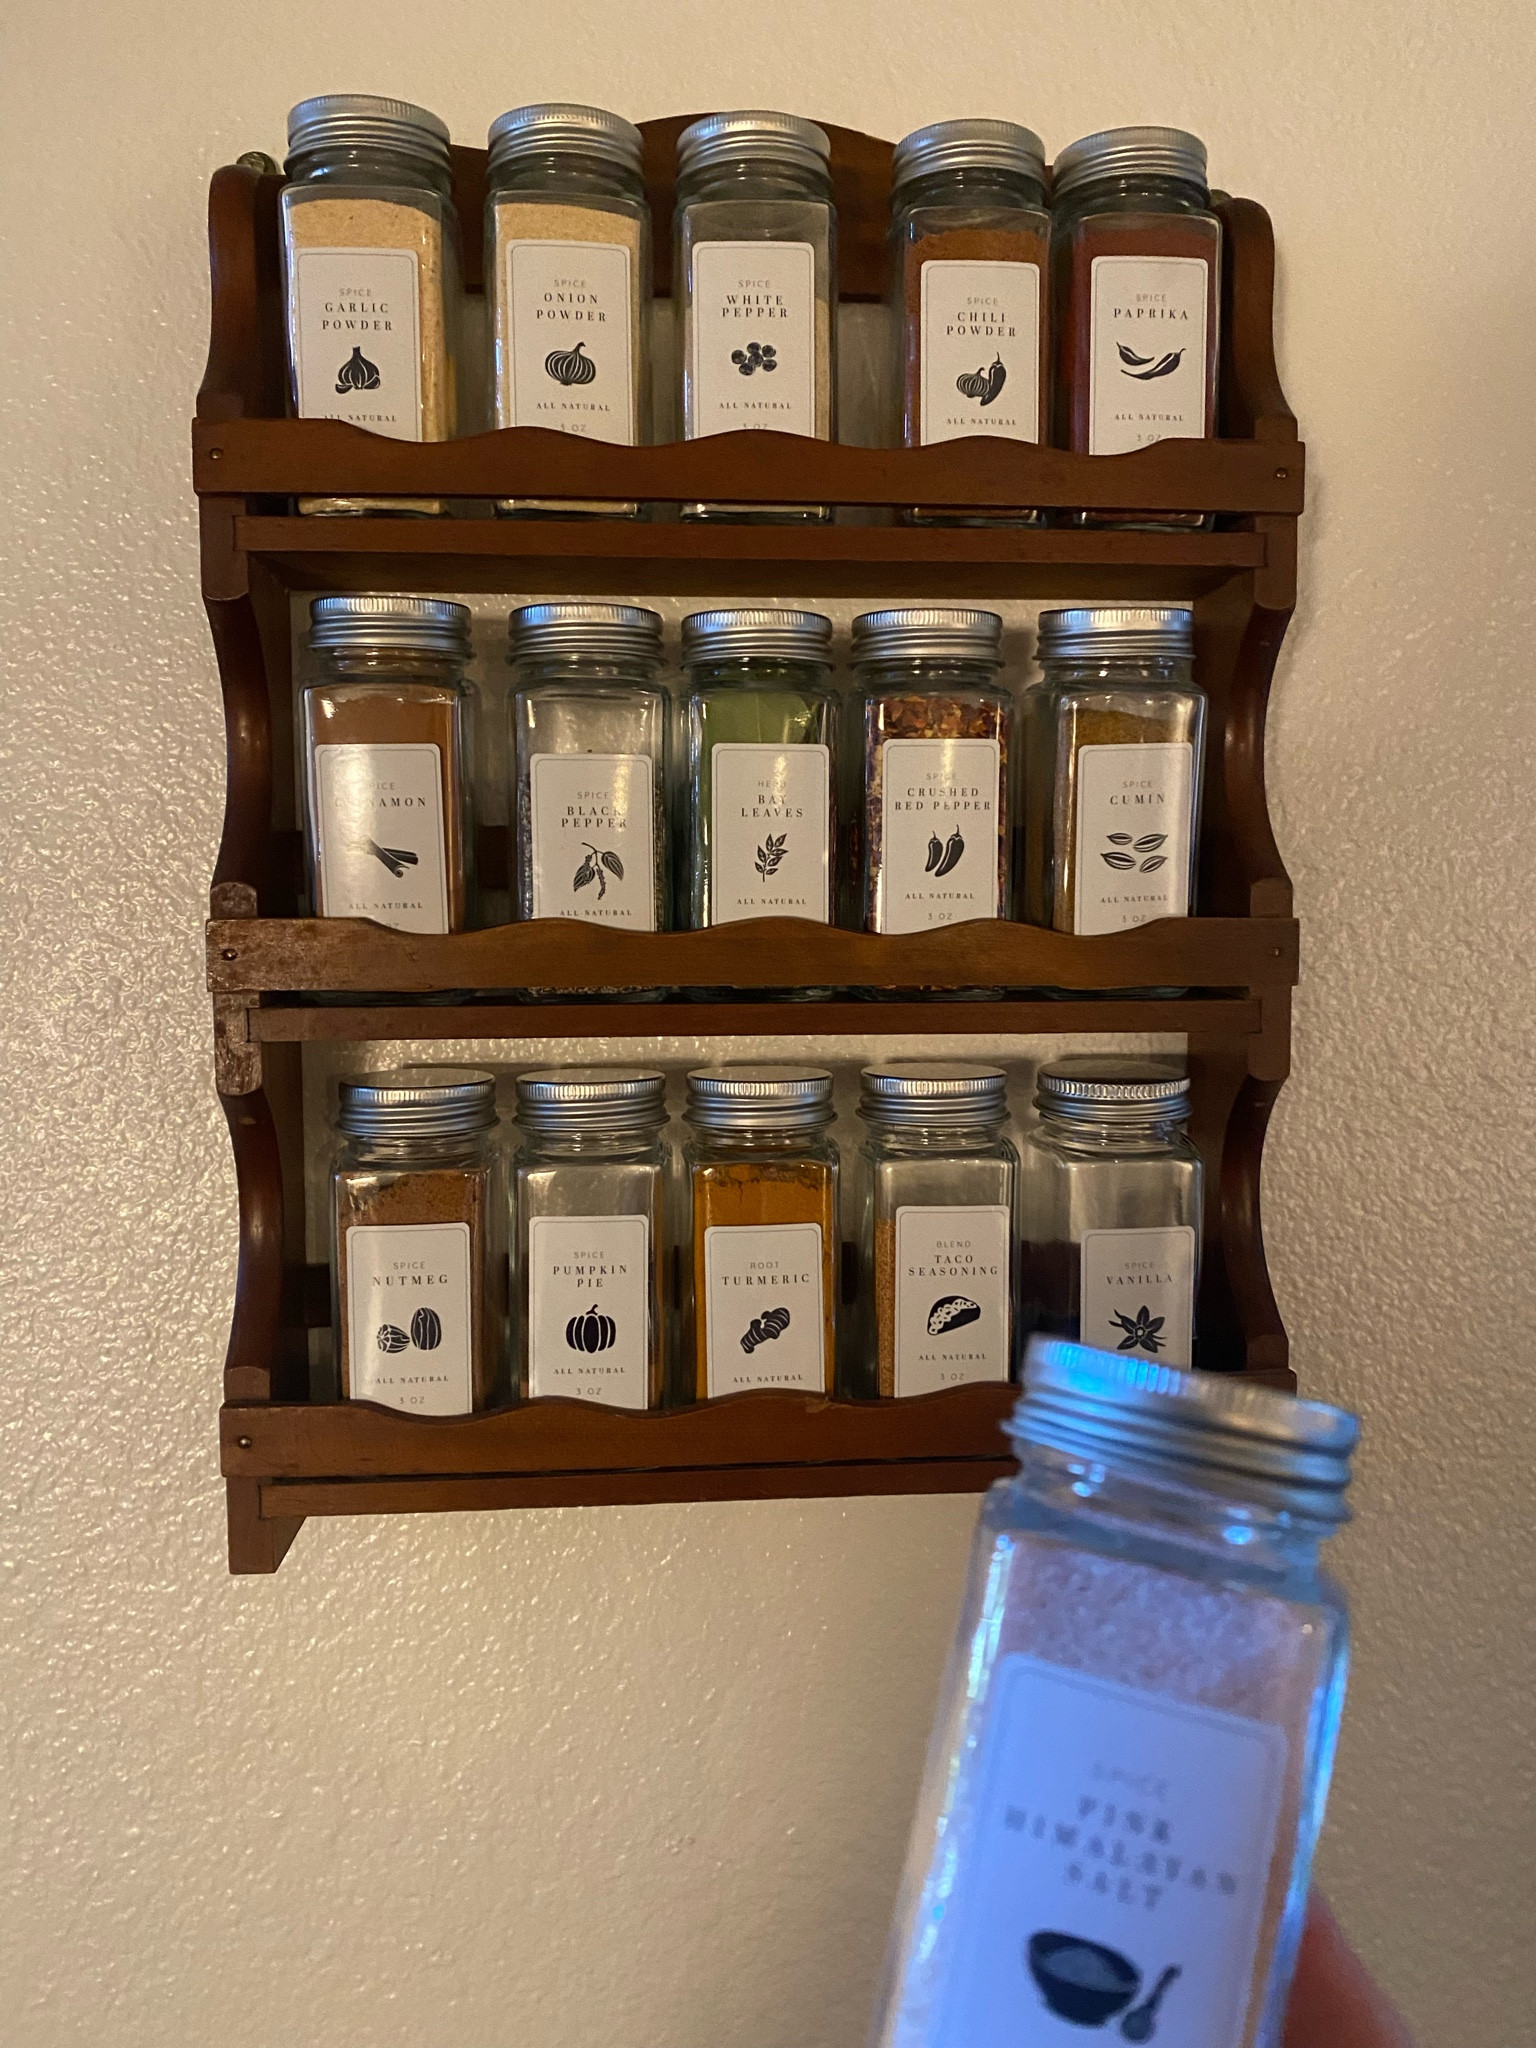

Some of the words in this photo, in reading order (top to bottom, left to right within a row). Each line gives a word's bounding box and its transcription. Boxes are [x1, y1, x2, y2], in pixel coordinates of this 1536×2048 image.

[554, 280, 586, 288] SPICE
[739, 280, 771, 288] SPICE
[339, 288, 372, 297] SPICE
[544, 293, 598, 304] ONION
[727, 295, 783, 305] WHITE
[1136, 294, 1167, 302] SPICE
[325, 303, 388, 313] GARLIC
[722, 308, 787, 317] PEPPER
[537, 310, 606, 322] POWDER
[957, 312, 1005, 322] CHILI
[1114, 308, 1188, 320] PAPRIKA
[322, 320, 392, 330] POWDER
[947, 326, 1016, 337] POWDER
[562, 403, 610, 411] NATURAL
[571, 424, 586, 432] OZ
[907, 788, 979, 797] CRUSHED
[335, 798, 426, 807] CAMON
[758, 795, 787, 804] BAY
[1110, 794, 1165, 805] CUMIN
[895, 802, 924, 810] RED
[933, 801, 991, 810] PEPPER
[567, 806, 623, 816] BLACK
[741, 808, 803, 817] LEAVES
[561, 818, 627, 828] PEPPER
[1132, 915, 1146, 923] OZ
[574, 1251, 605, 1259] SPICE
[934, 1255, 973, 1264] TACO
[393, 1262, 426, 1270] SPICE
[553, 1265, 627, 1275] PUMPKIN
[750, 1262, 779, 1270] ROOT
[1125, 1262, 1154, 1270] SPICE
[909, 1266, 998, 1276] SEASONING
[373, 1275, 448, 1286] NUTMEG
[577, 1279, 603, 1288] PIE
[722, 1274, 810, 1285] TURMERIC
[1107, 1274, 1173, 1285] VANILLA
[757, 1374, 803, 1382] NATURAL
[951, 1373, 965, 1381] OZ
[410, 1396, 425, 1404] OZ
